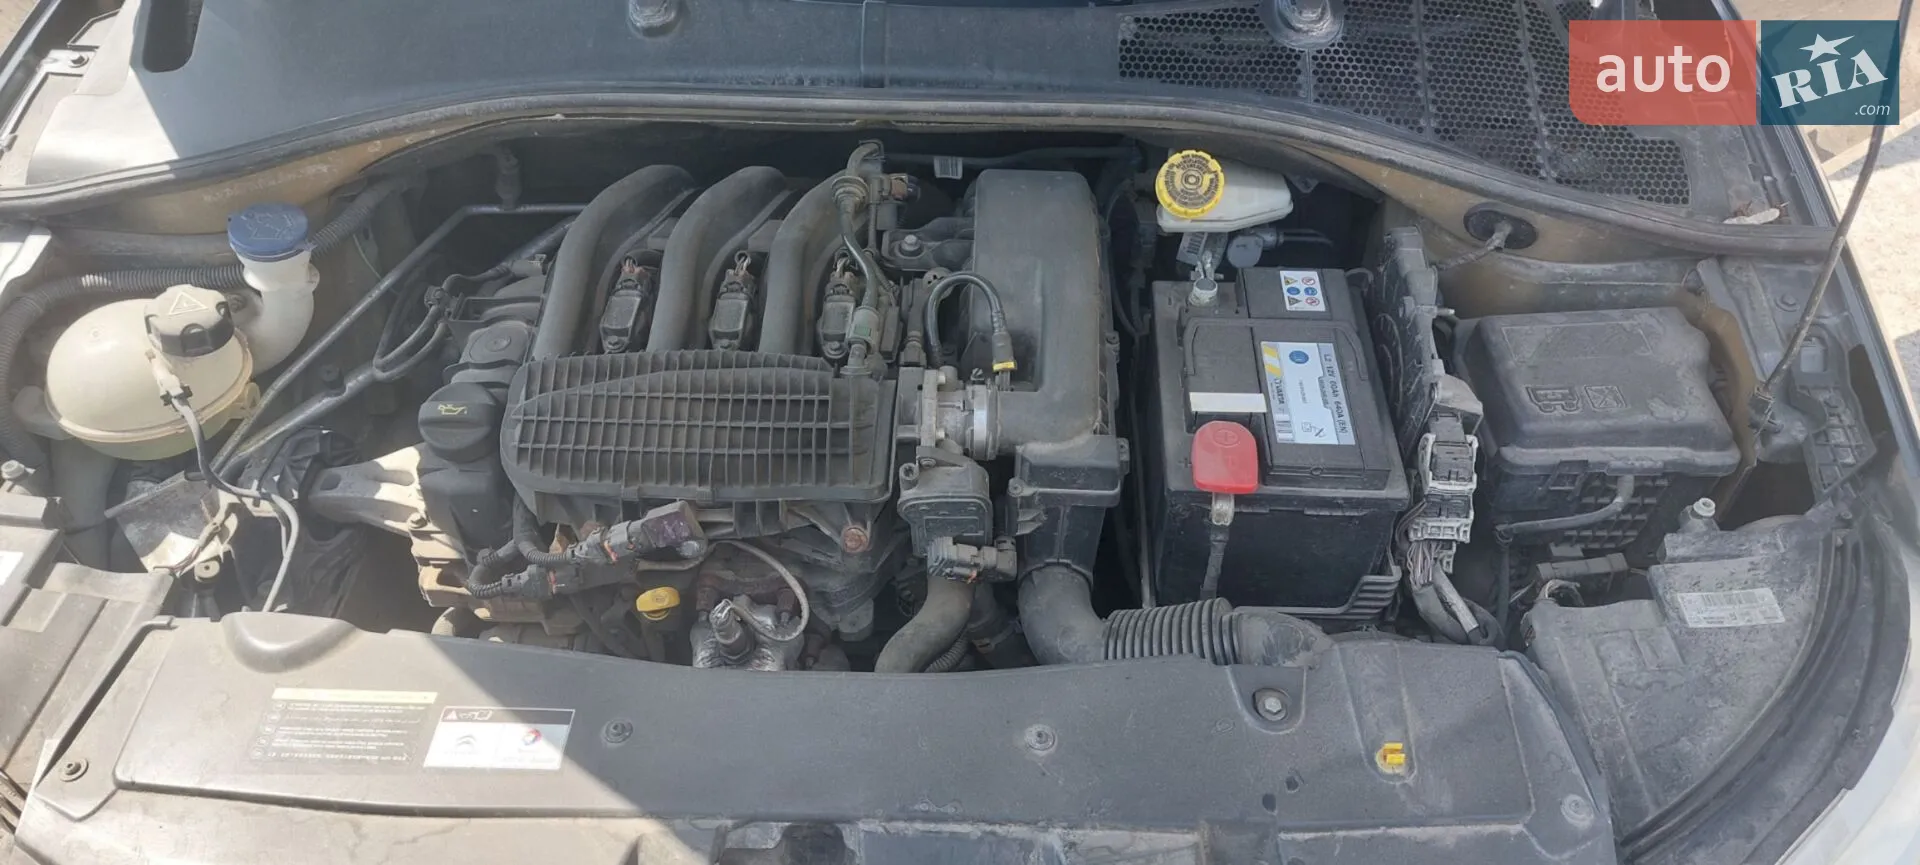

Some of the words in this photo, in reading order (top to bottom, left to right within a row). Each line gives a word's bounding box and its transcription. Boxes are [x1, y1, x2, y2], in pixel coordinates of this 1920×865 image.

[1326, 365, 1336, 380] 12V
[1329, 380, 1340, 398] 60Ah
[1334, 400, 1345, 419] 640A
